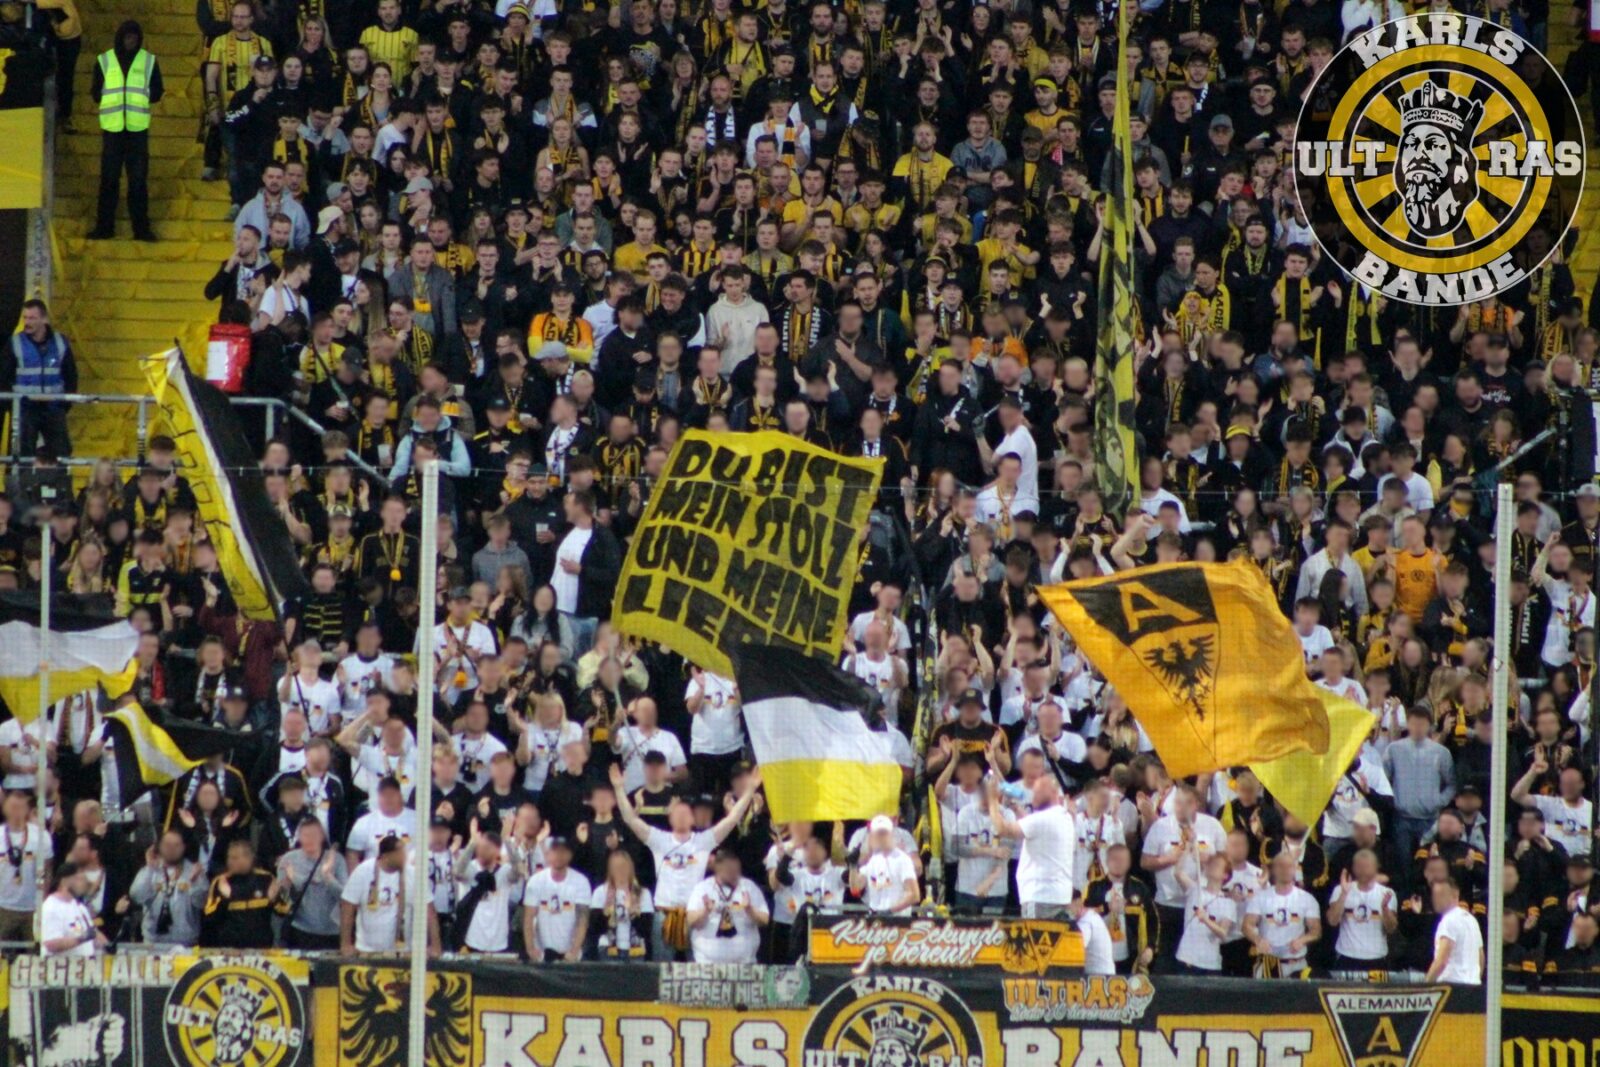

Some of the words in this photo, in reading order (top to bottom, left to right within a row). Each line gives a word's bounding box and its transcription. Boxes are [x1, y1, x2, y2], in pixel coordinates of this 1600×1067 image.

[669, 439, 752, 483] DU
[753, 448, 876, 522] BIST
[650, 480, 751, 541] MEIN
[748, 497, 856, 590] STOLZ
[636, 525, 720, 583] UND
[723, 547, 841, 645] MEINE
[1116, 581, 1203, 632] A
[829, 919, 899, 948] Keine
[903, 920, 1006, 948] Sekunde
[9, 954, 103, 988] GEGEN
[110, 954, 175, 987] ALLE
[660, 962, 764, 981] LEGENDEN
[851, 942, 888, 974] je
[891, 940, 982, 965] bereut!
[660, 981, 732, 1001] STERBEN
[851, 975, 944, 1003] KARLS
[1003, 976, 1129, 1009] ULTRAS
[1335, 996, 1435, 1011] ALEMANNIA
[166, 1003, 210, 1029] ULT
[258, 1023, 302, 1048] RAS
[480, 1010, 788, 1067] KARLS
[1366, 1015, 1402, 1053] A
